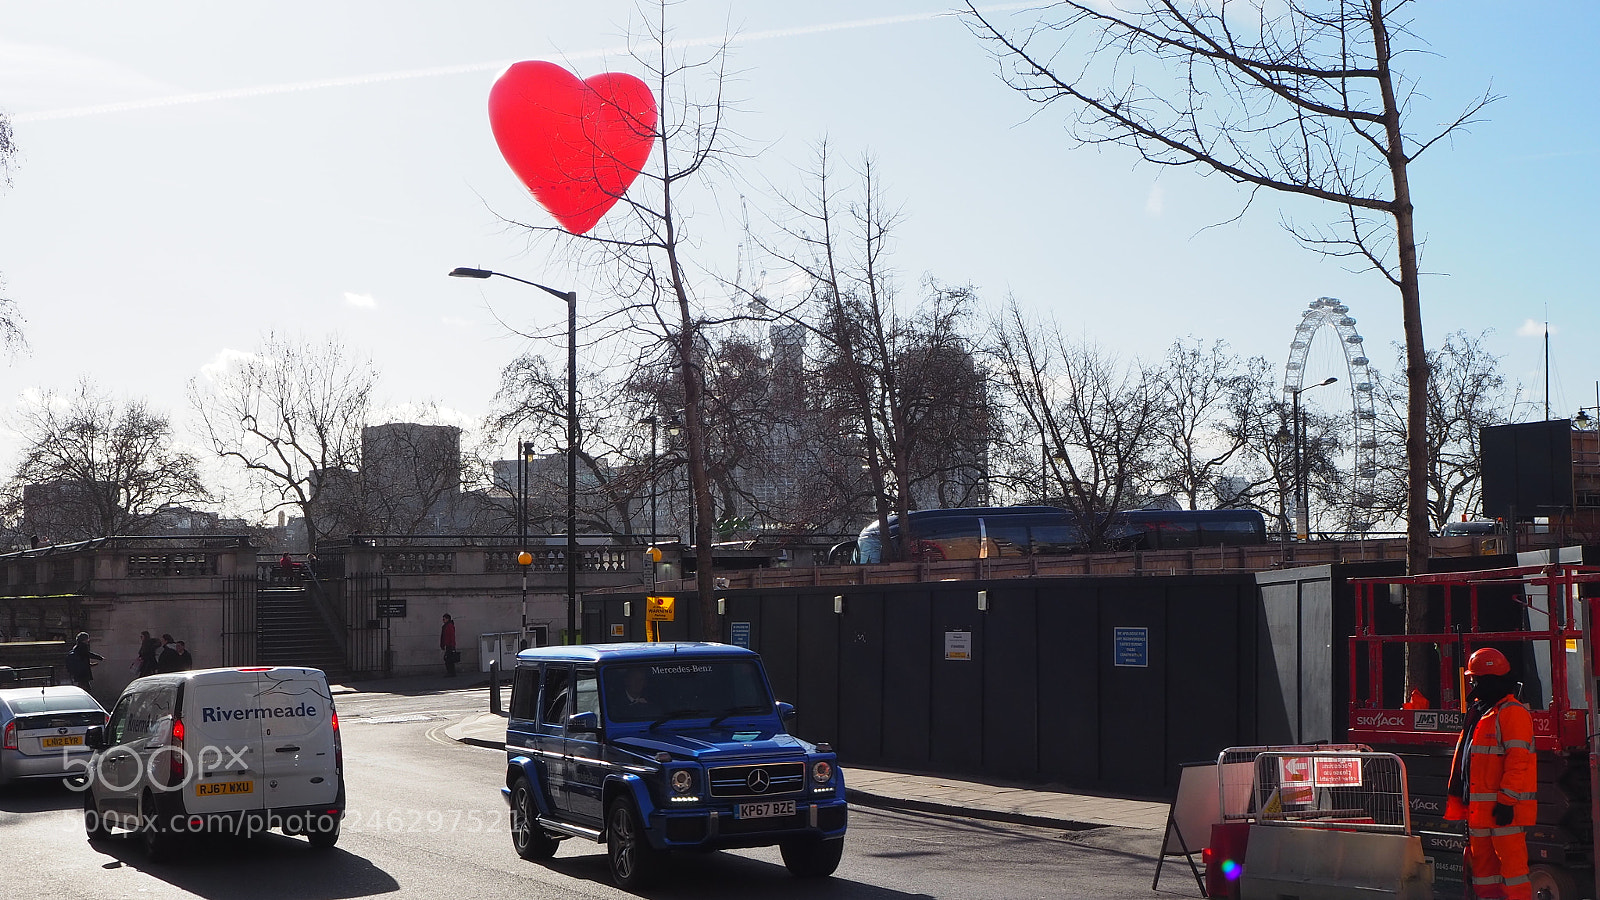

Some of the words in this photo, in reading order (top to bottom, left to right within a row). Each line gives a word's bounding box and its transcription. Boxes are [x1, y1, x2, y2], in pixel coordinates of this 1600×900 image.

[651, 664, 713, 675] Mercedes-Benz
[202, 702, 317, 723] Rivermeade
[1439, 713, 1459, 724] 0845
[1356, 712, 1405, 728] SKYJACK
[200, 784, 227, 794] RJ67
[229, 782, 249, 793] WXU
[741, 804, 770, 817] KP67
[773, 802, 794, 814] BZE
